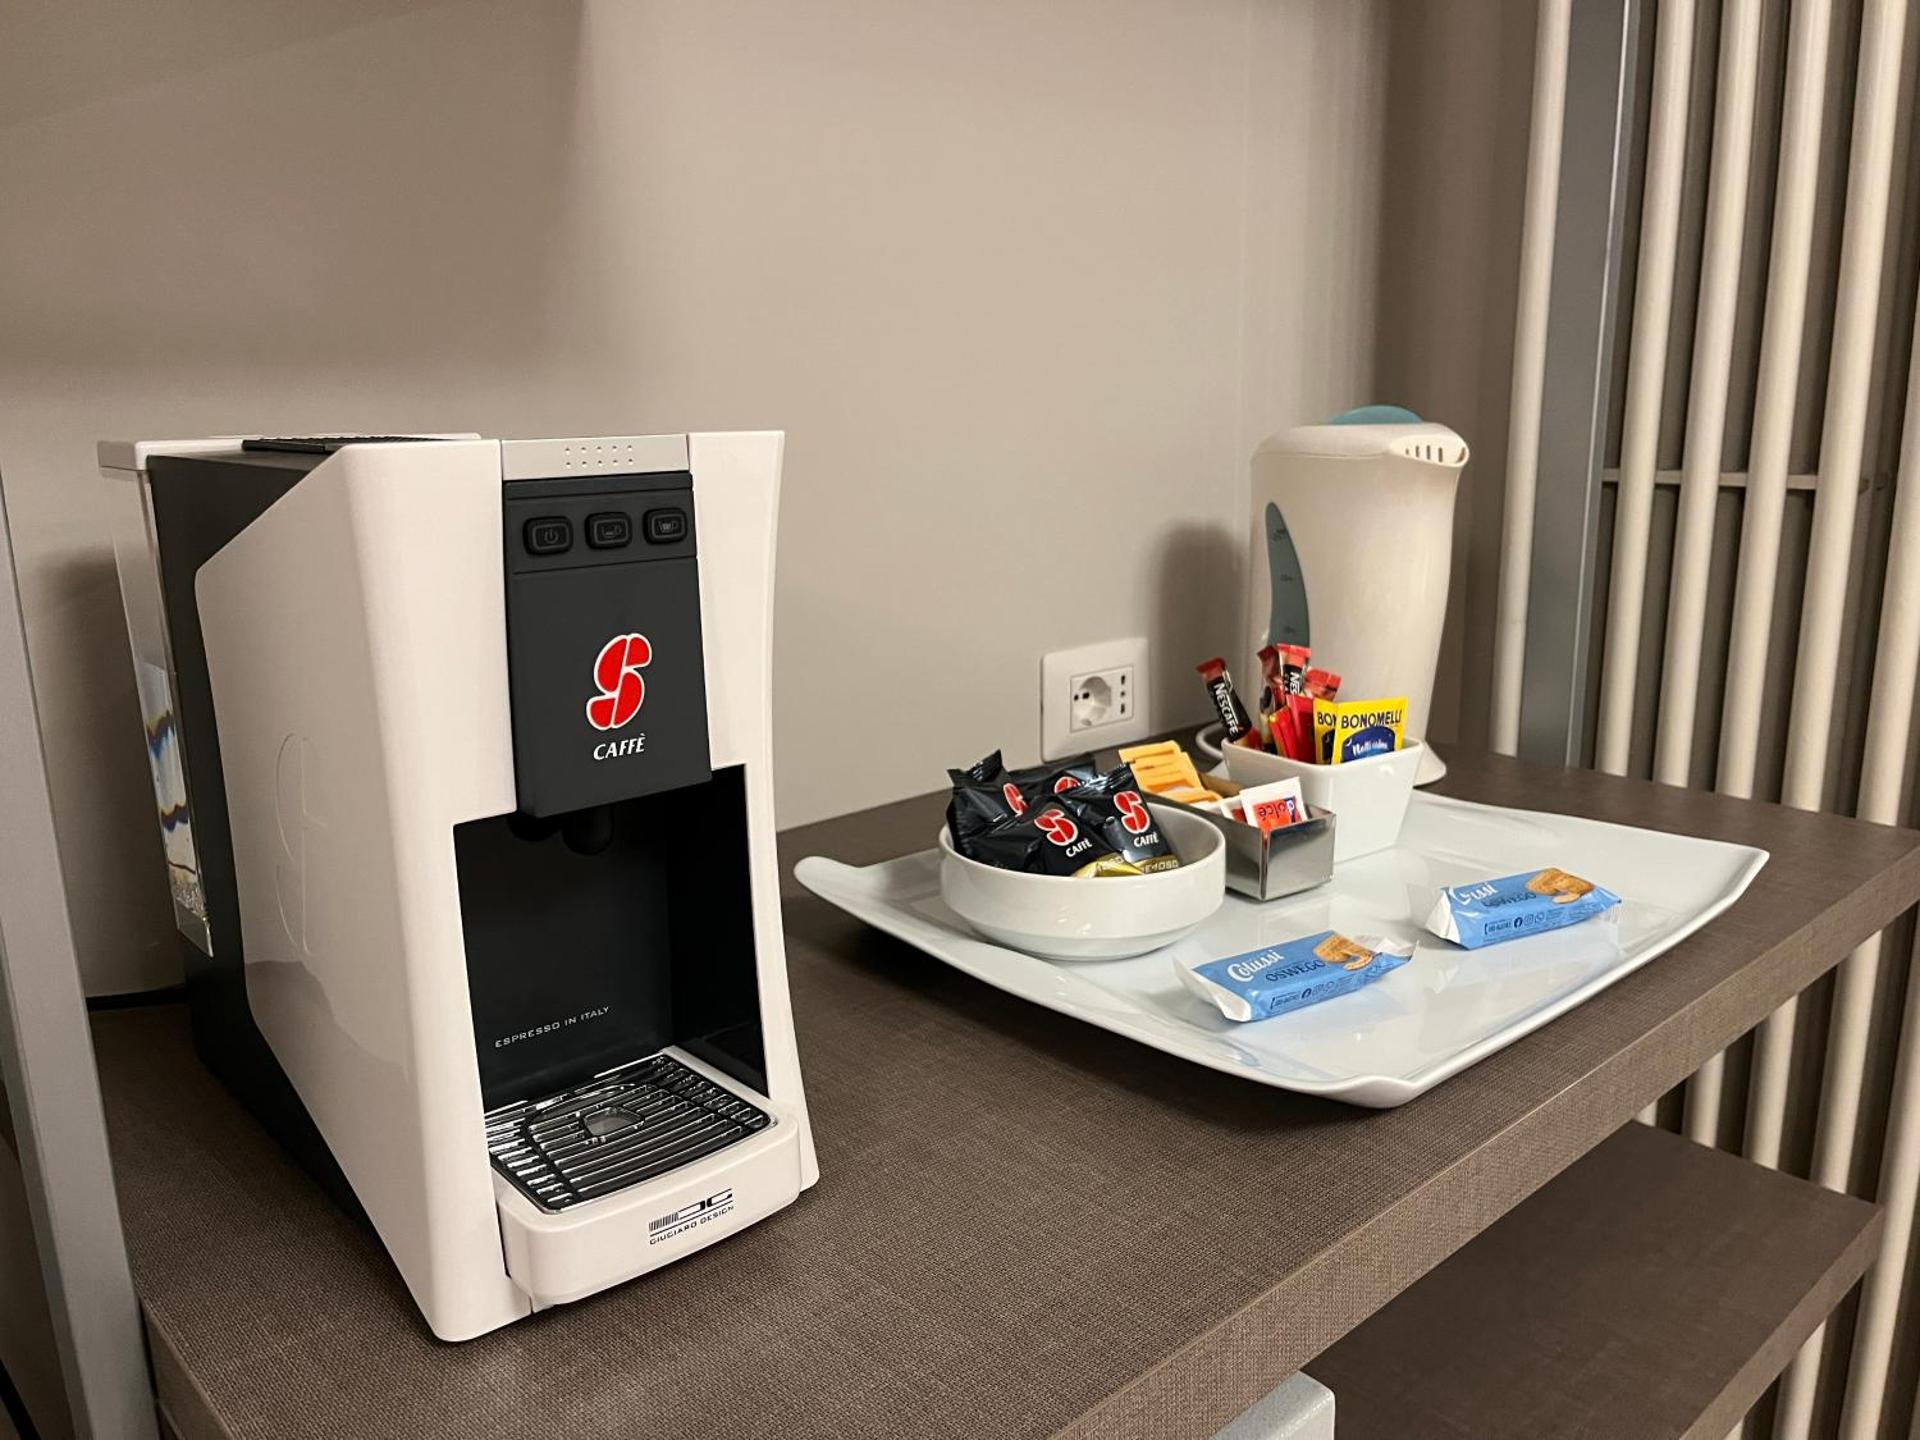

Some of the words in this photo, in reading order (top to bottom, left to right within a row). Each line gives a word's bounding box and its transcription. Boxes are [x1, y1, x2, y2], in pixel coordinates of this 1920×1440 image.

[1341, 710, 1402, 729] BONOMELLI
[593, 733, 646, 760] CAFFÈ
[1227, 949, 1285, 982] Colussi
[495, 1021, 560, 1047] ESPRESSO
[564, 1016, 577, 1026] IN
[580, 1006, 609, 1020] ITALY
[700, 1205, 734, 1224] DESIGN
